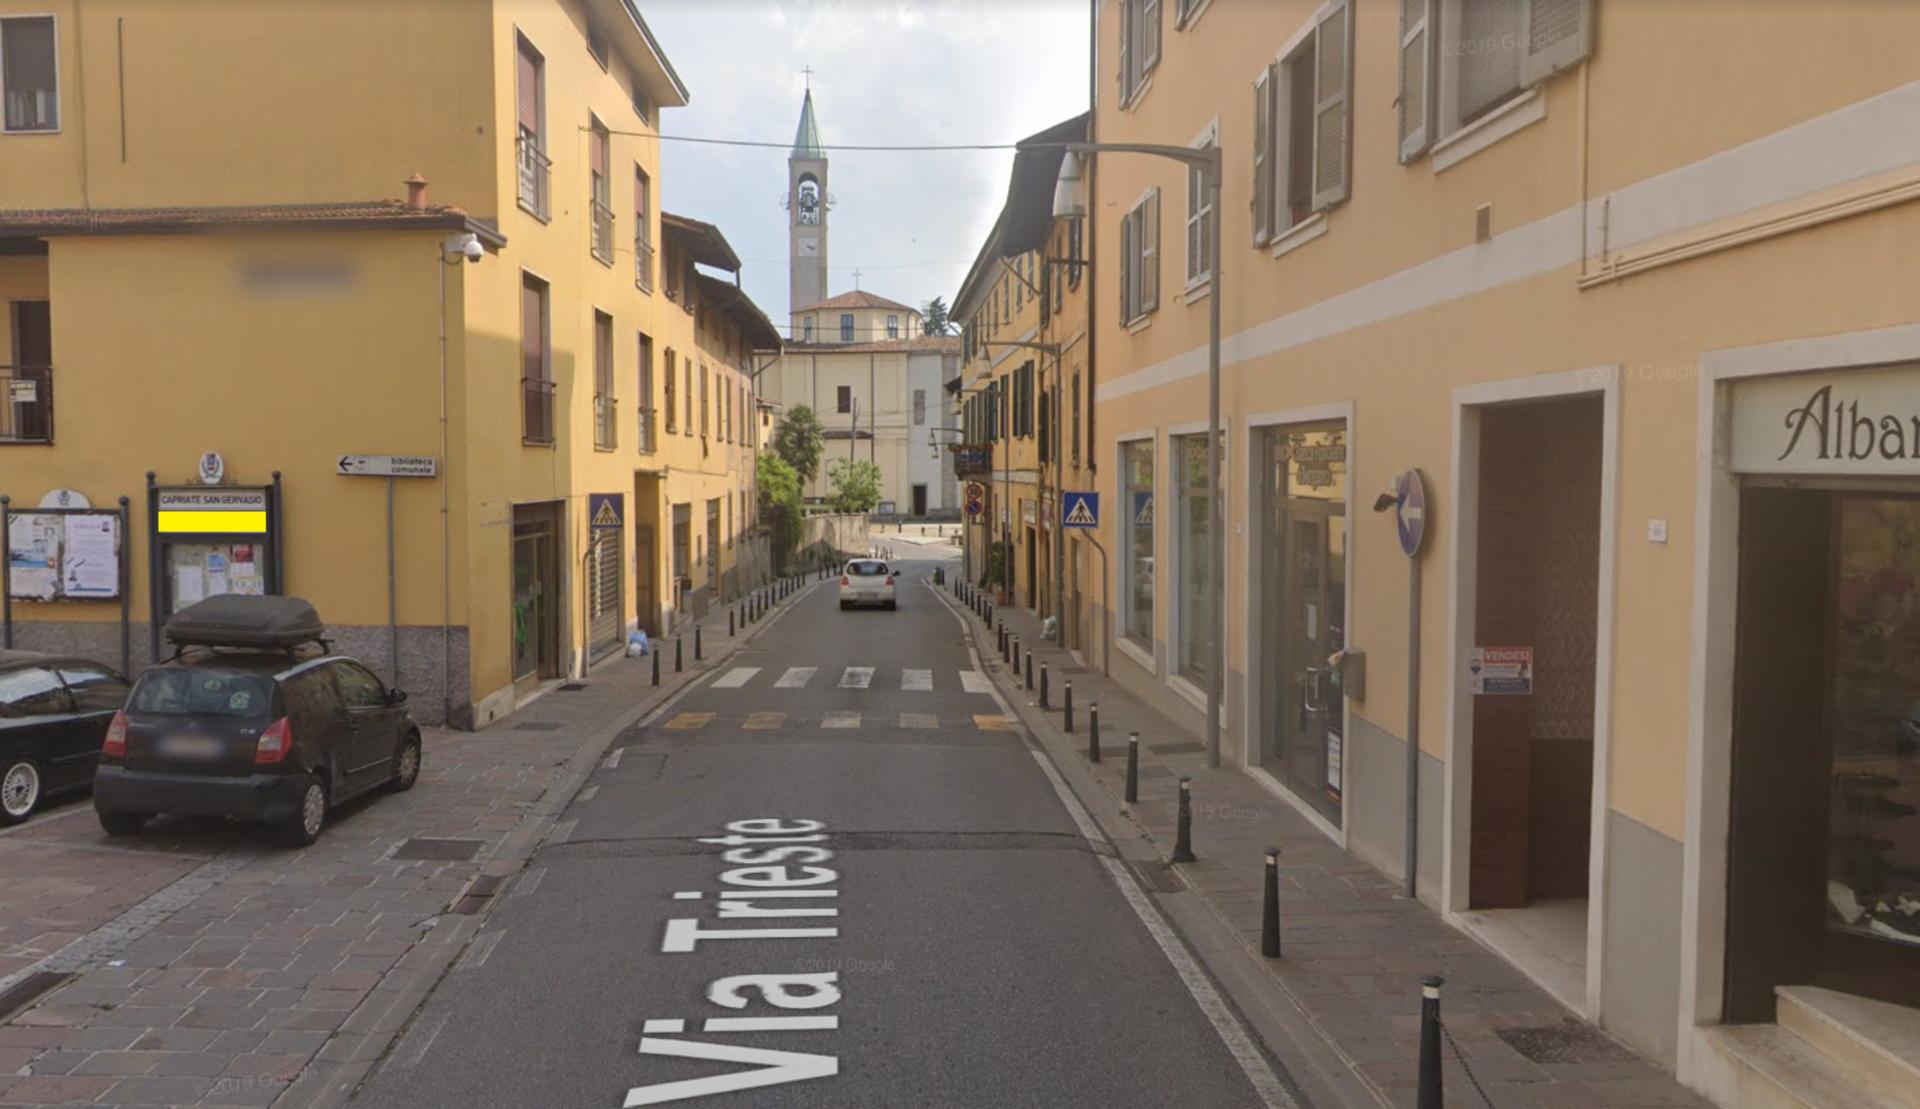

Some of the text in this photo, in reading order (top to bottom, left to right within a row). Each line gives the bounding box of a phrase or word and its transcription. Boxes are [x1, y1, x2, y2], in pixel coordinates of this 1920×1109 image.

[391, 457, 433, 465] biblioteca
[161, 495, 262, 505] CAPRIATE SAN GERVASIO
